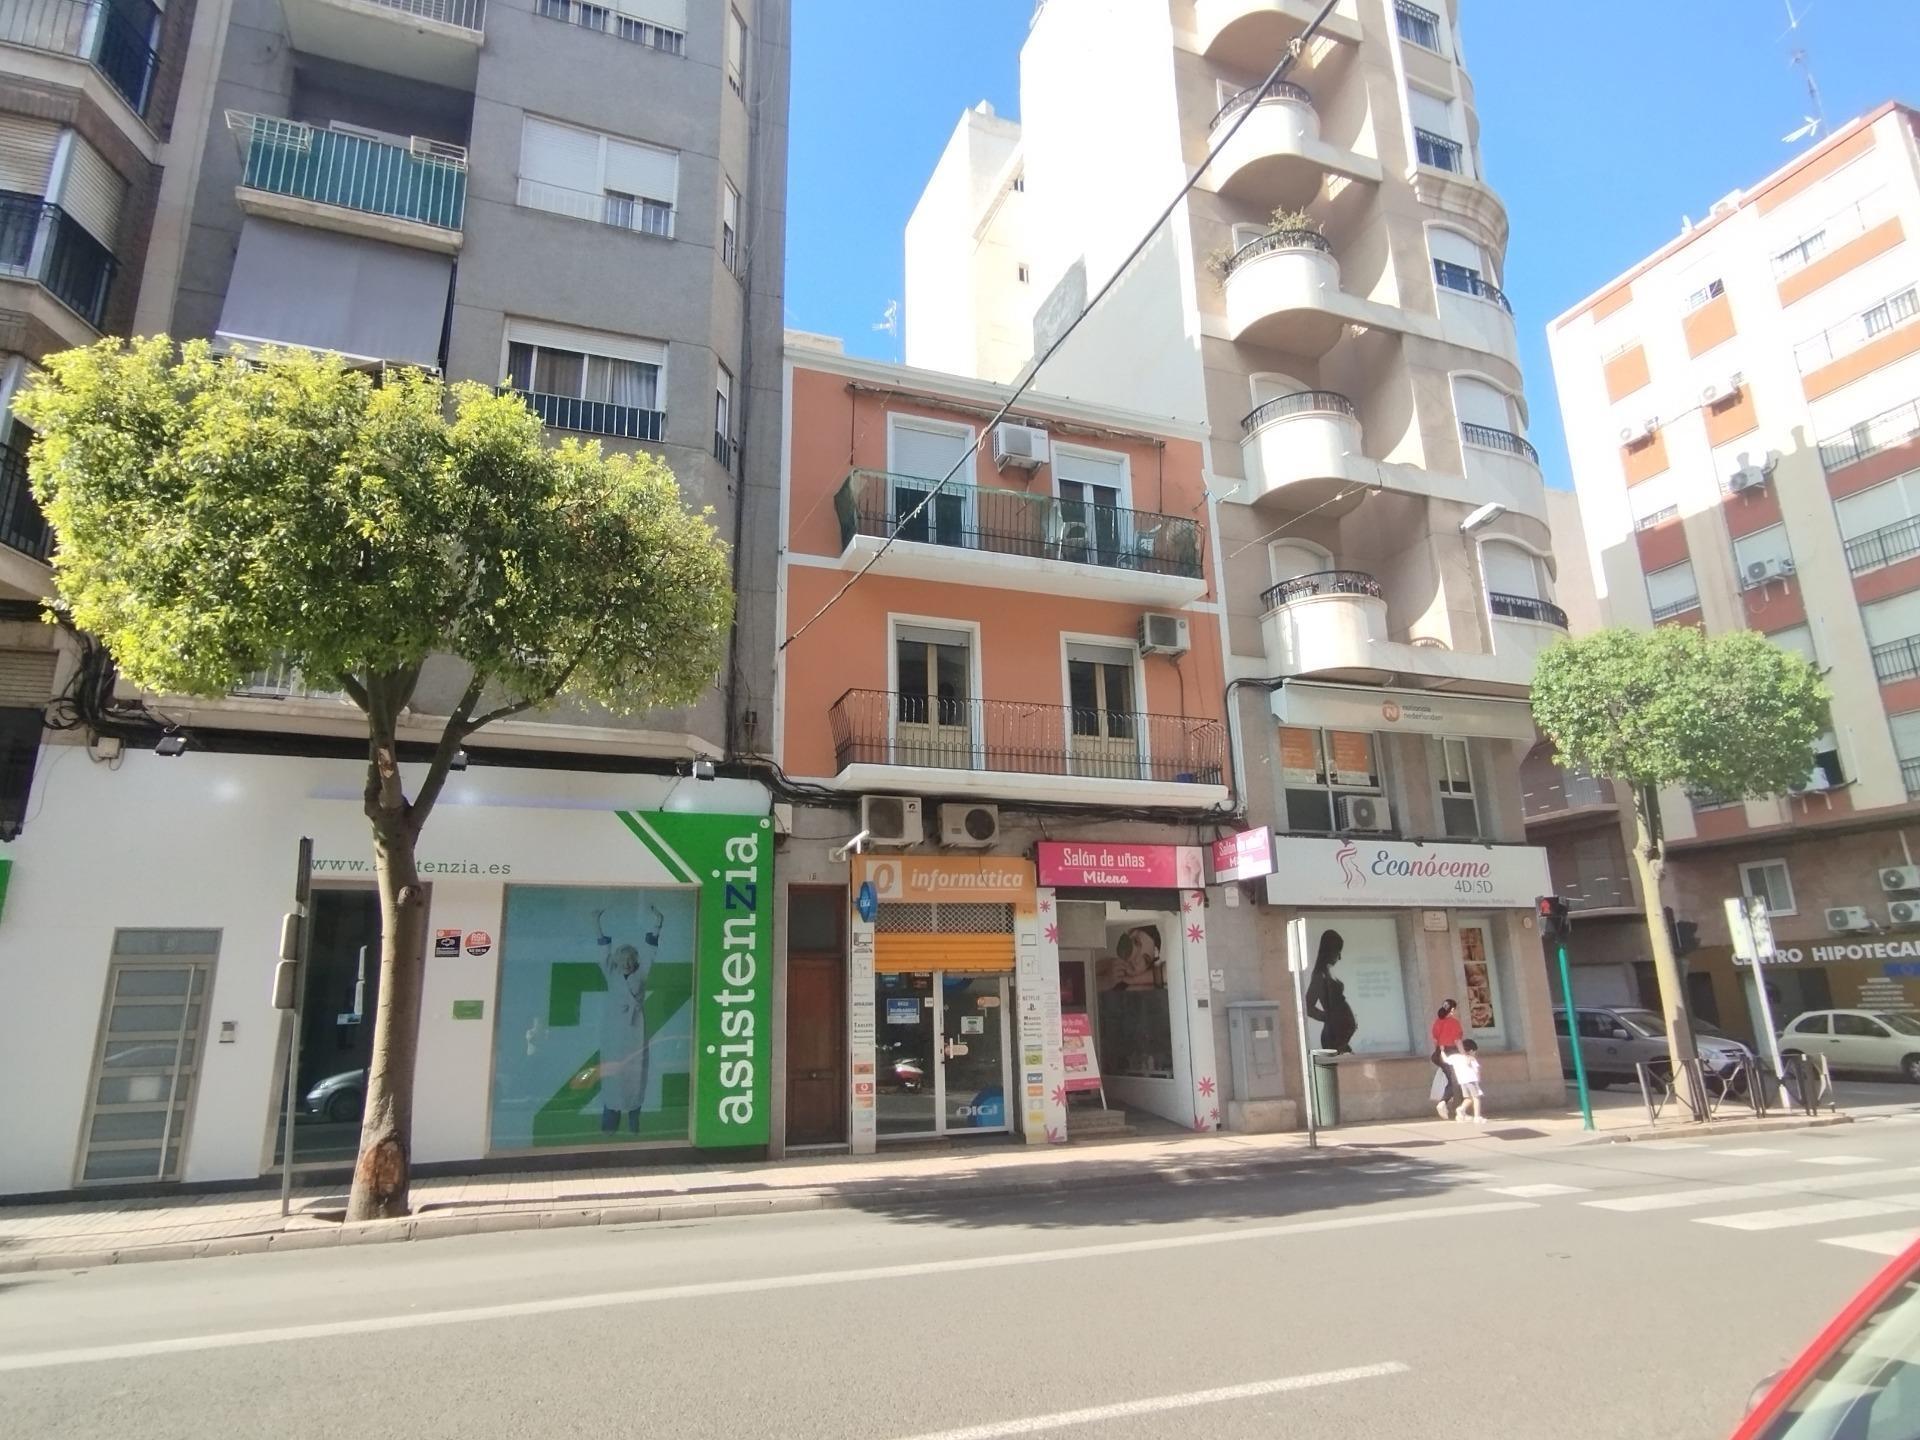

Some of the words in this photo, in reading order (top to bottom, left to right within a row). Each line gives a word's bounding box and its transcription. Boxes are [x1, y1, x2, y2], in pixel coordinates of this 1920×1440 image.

[311, 860, 511, 874] www.tenzia.es
[1064, 848, 1096, 867] Salón
[1100, 849, 1114, 867] de
[1117, 852, 1145, 868] uñas
[1371, 850, 1490, 878] Econóceme
[911, 868, 1024, 892] informática
[1083, 870, 1128, 884] Milena
[707, 833, 757, 1124] asistenzia
[956, 1104, 998, 1117] DIGI
